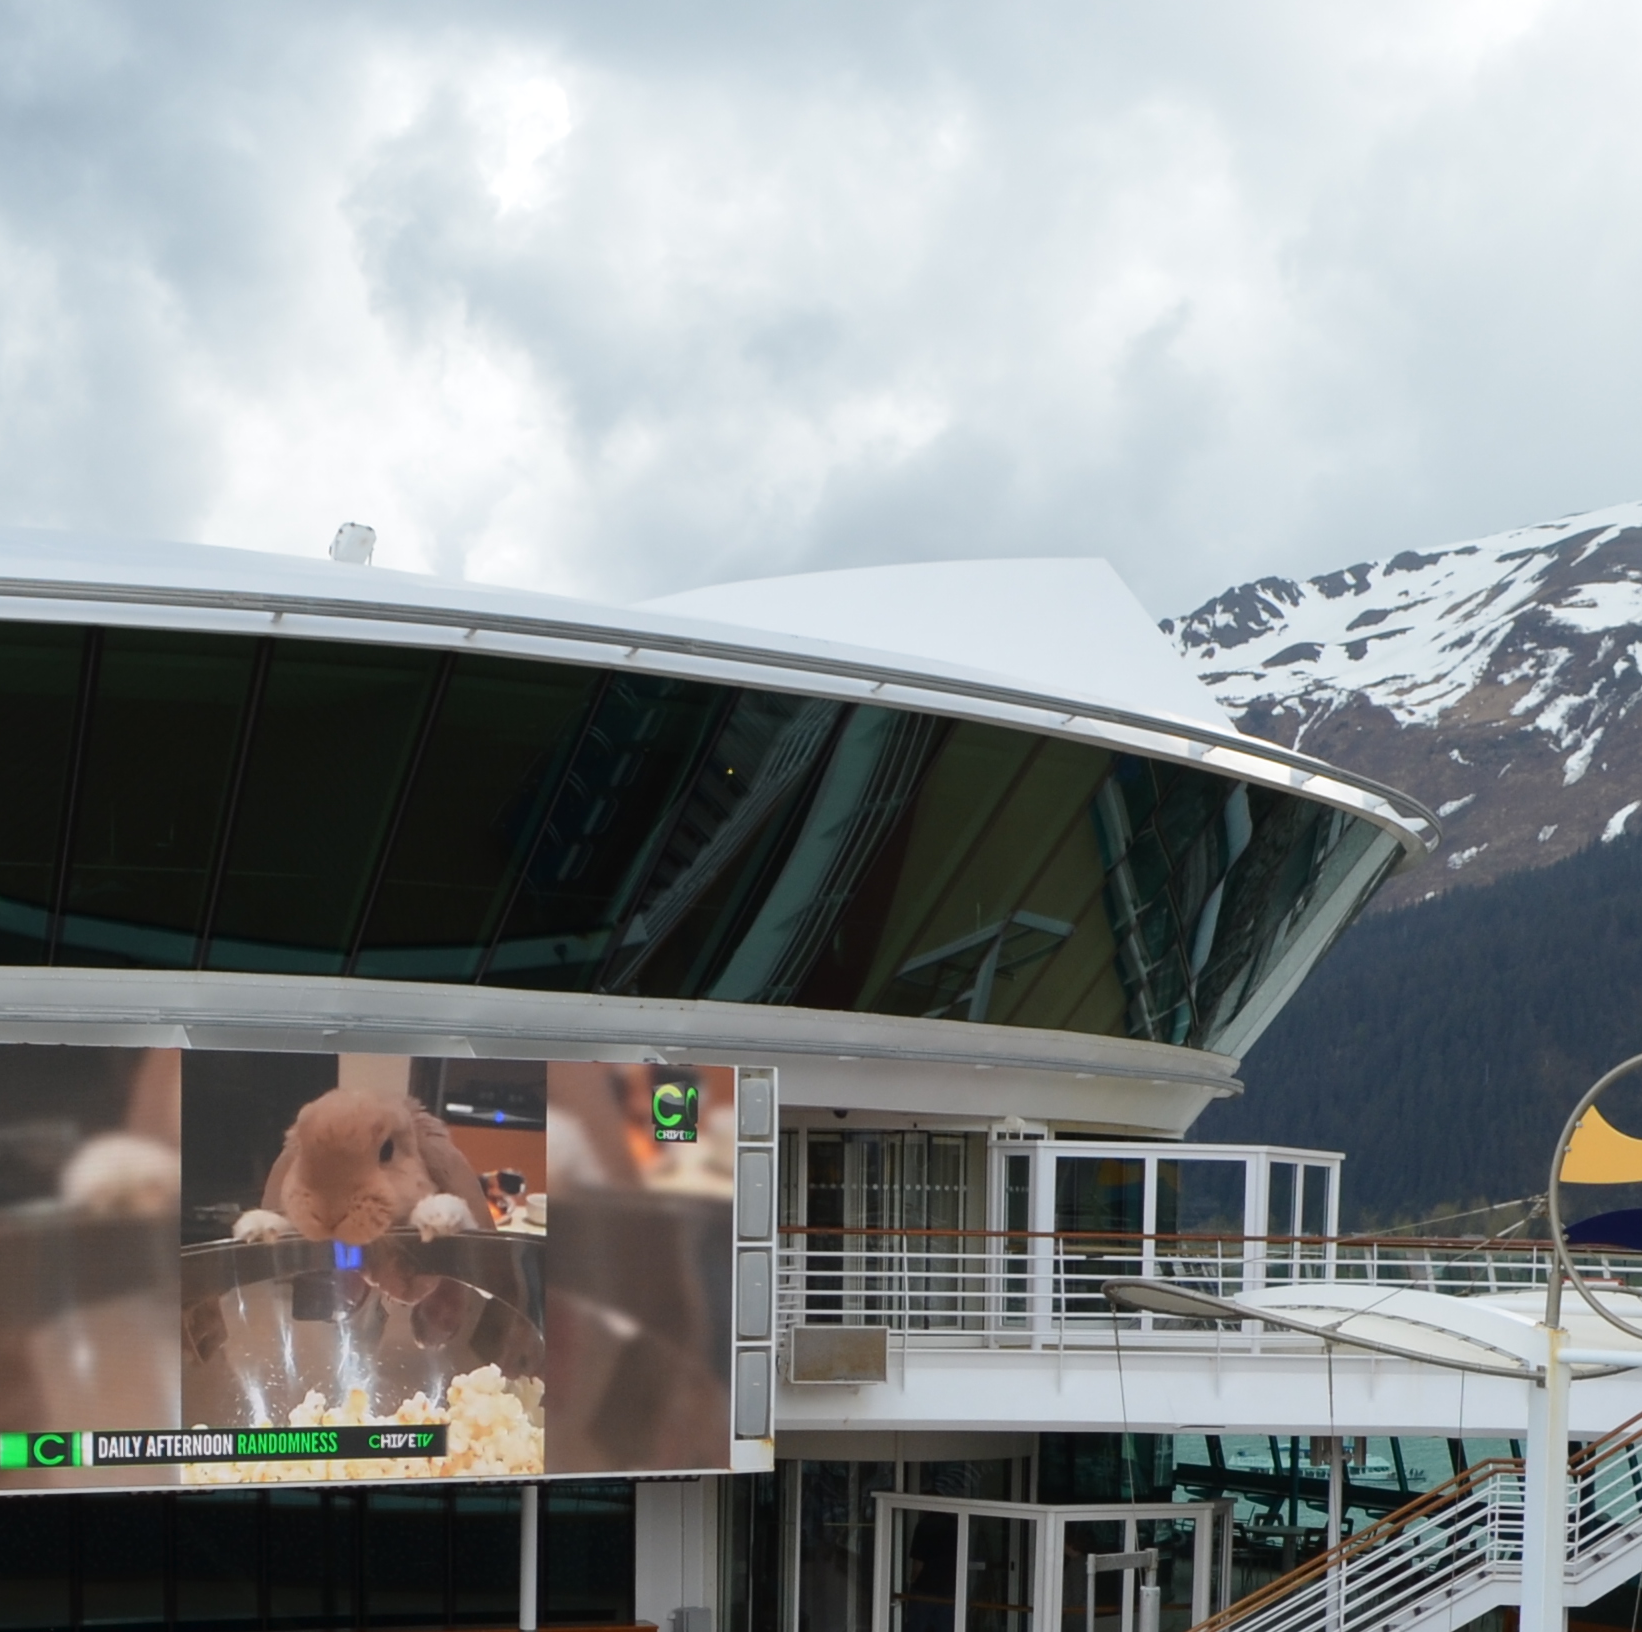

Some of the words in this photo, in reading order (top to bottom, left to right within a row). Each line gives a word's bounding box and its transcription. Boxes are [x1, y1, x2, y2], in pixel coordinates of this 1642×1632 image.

[98, 1435, 143, 1459] DAILY
[145, 1433, 233, 1458] AFTERNOON
[237, 1432, 338, 1455] RANDOMNESS
[368, 1433, 434, 1449] CHIVETV
